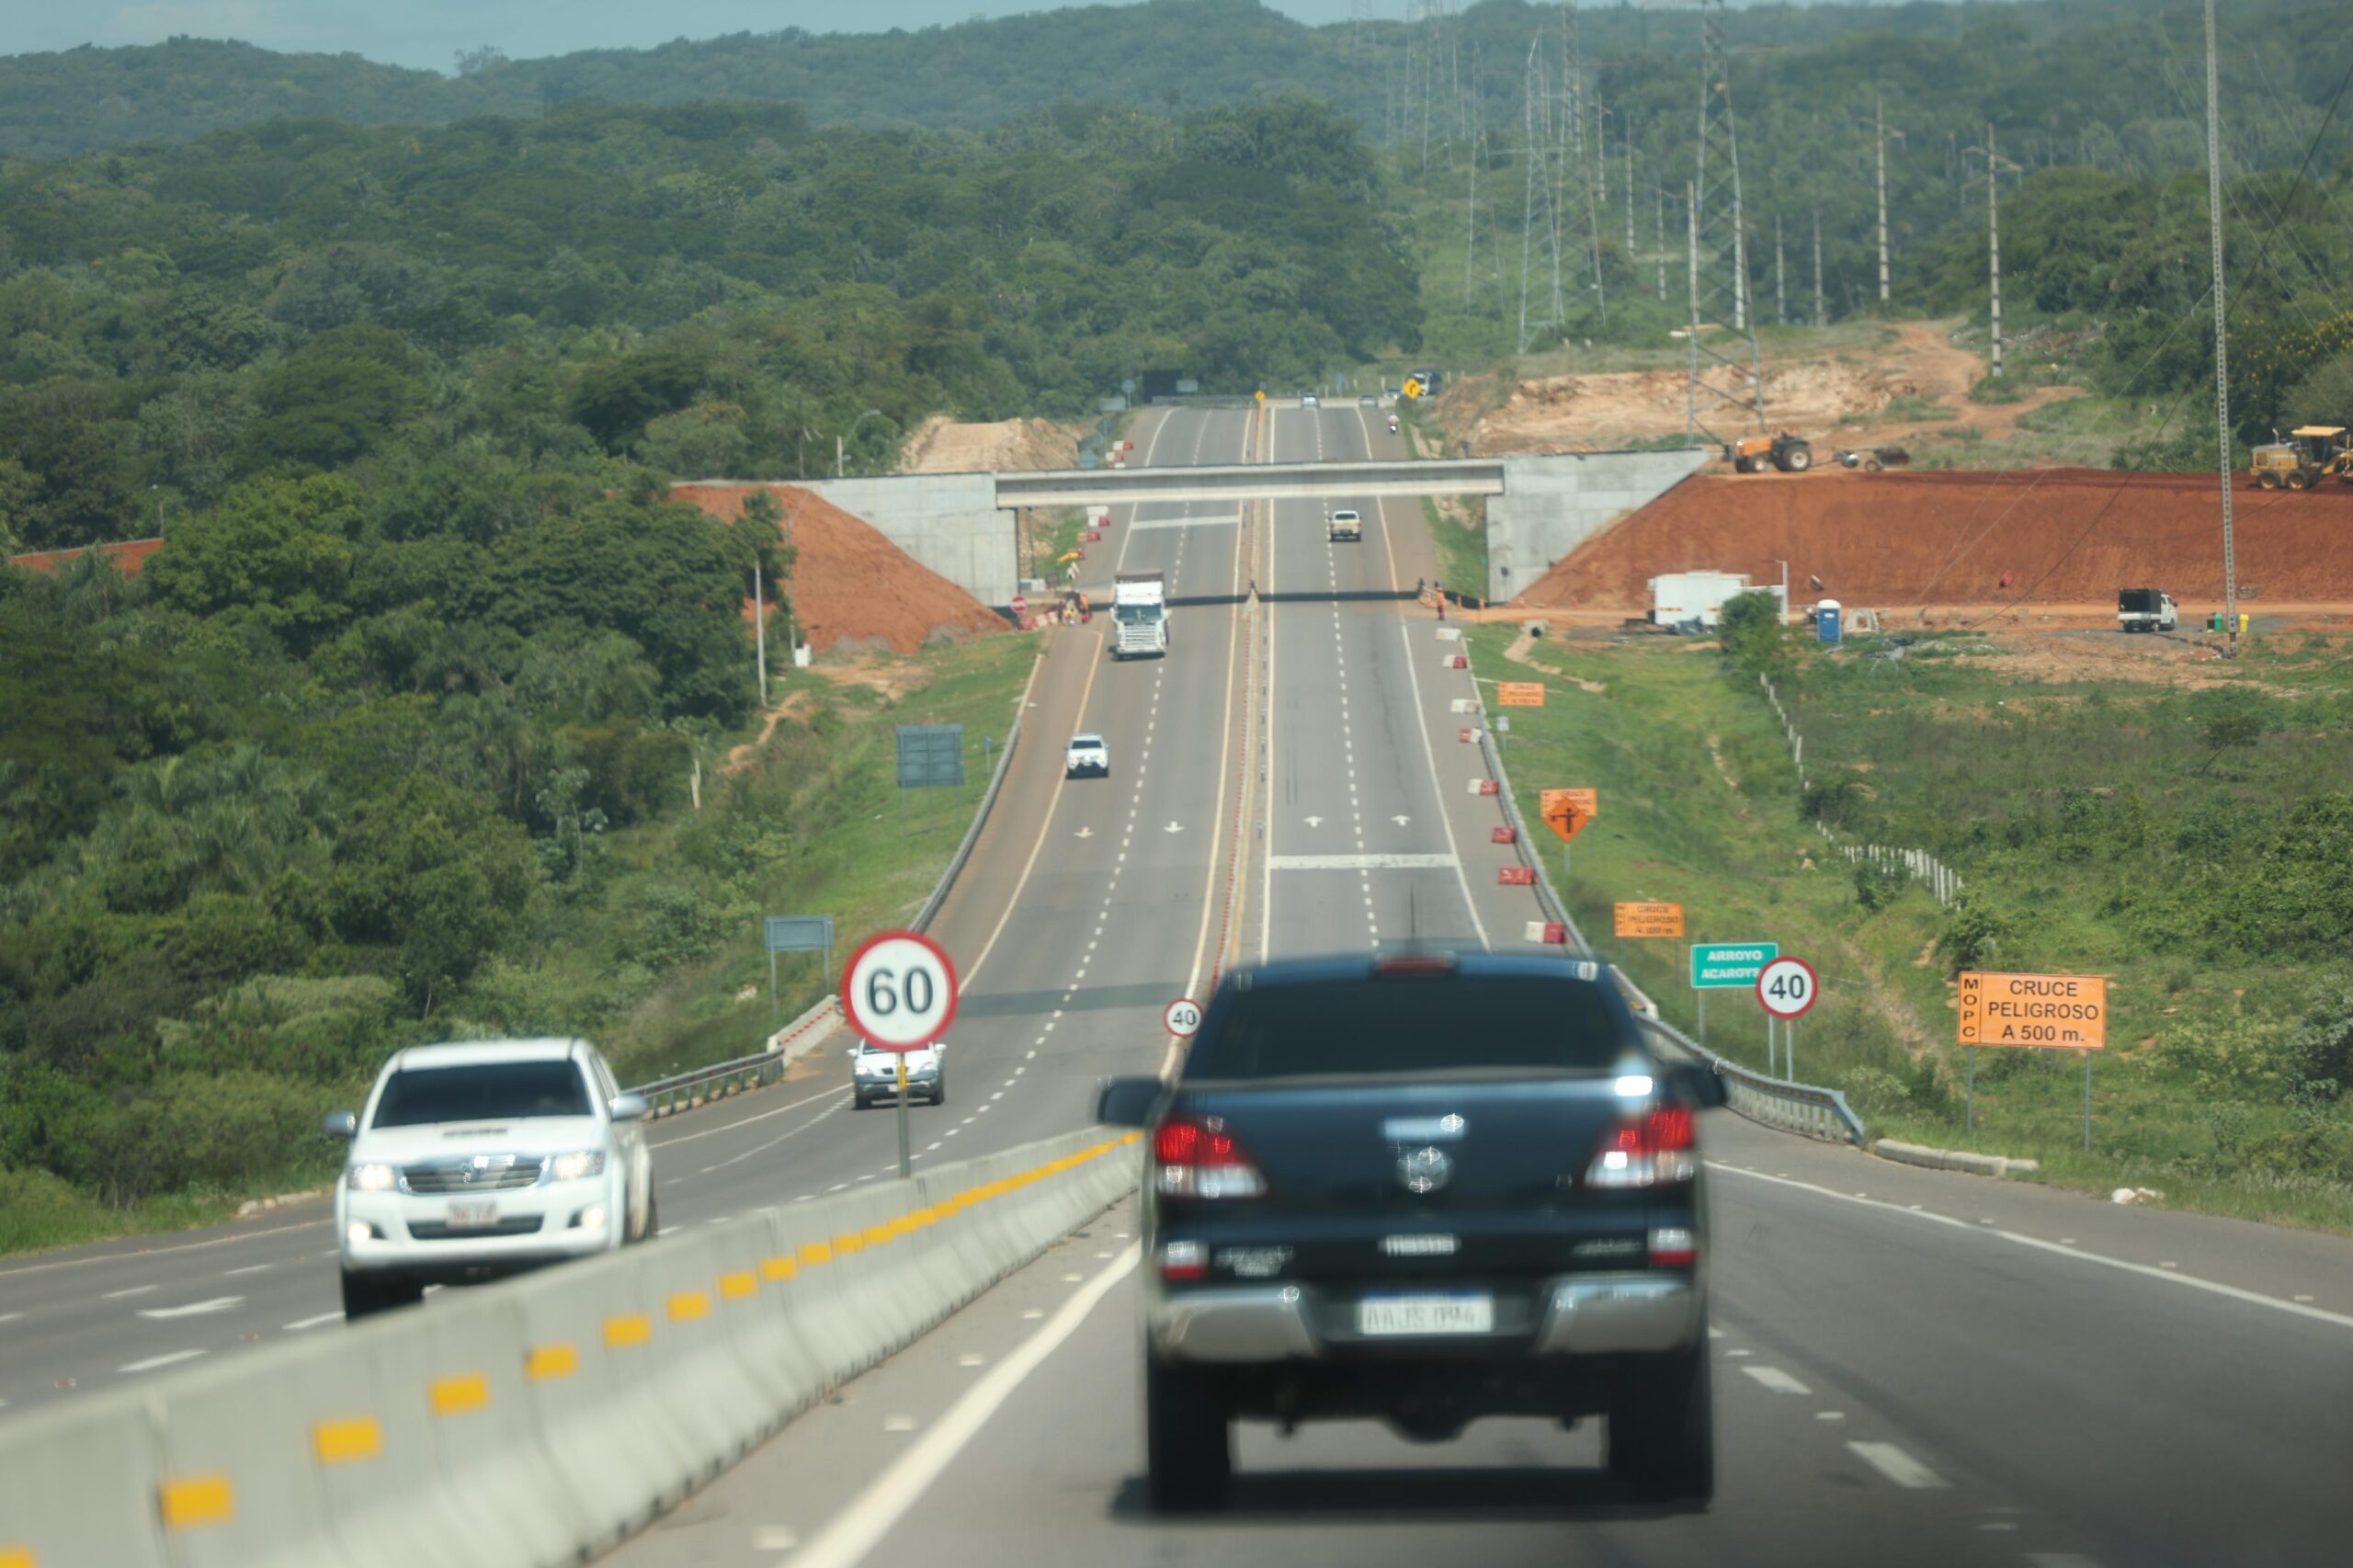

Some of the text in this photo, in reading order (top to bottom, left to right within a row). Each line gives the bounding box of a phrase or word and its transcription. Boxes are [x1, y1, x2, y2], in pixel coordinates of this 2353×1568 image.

[1707, 950, 1764, 961] ARROYO
[1701, 967, 1760, 979] ACAROYS
[866, 966, 933, 1017] 60
[1768, 974, 1805, 1000] 40
[2010, 980, 2078, 997] CRUCE
[1173, 1009, 1197, 1026] 40
[1988, 1001, 2098, 1020] PELIGROSO
[2002, 1024, 2085, 1042] A 500 m.
